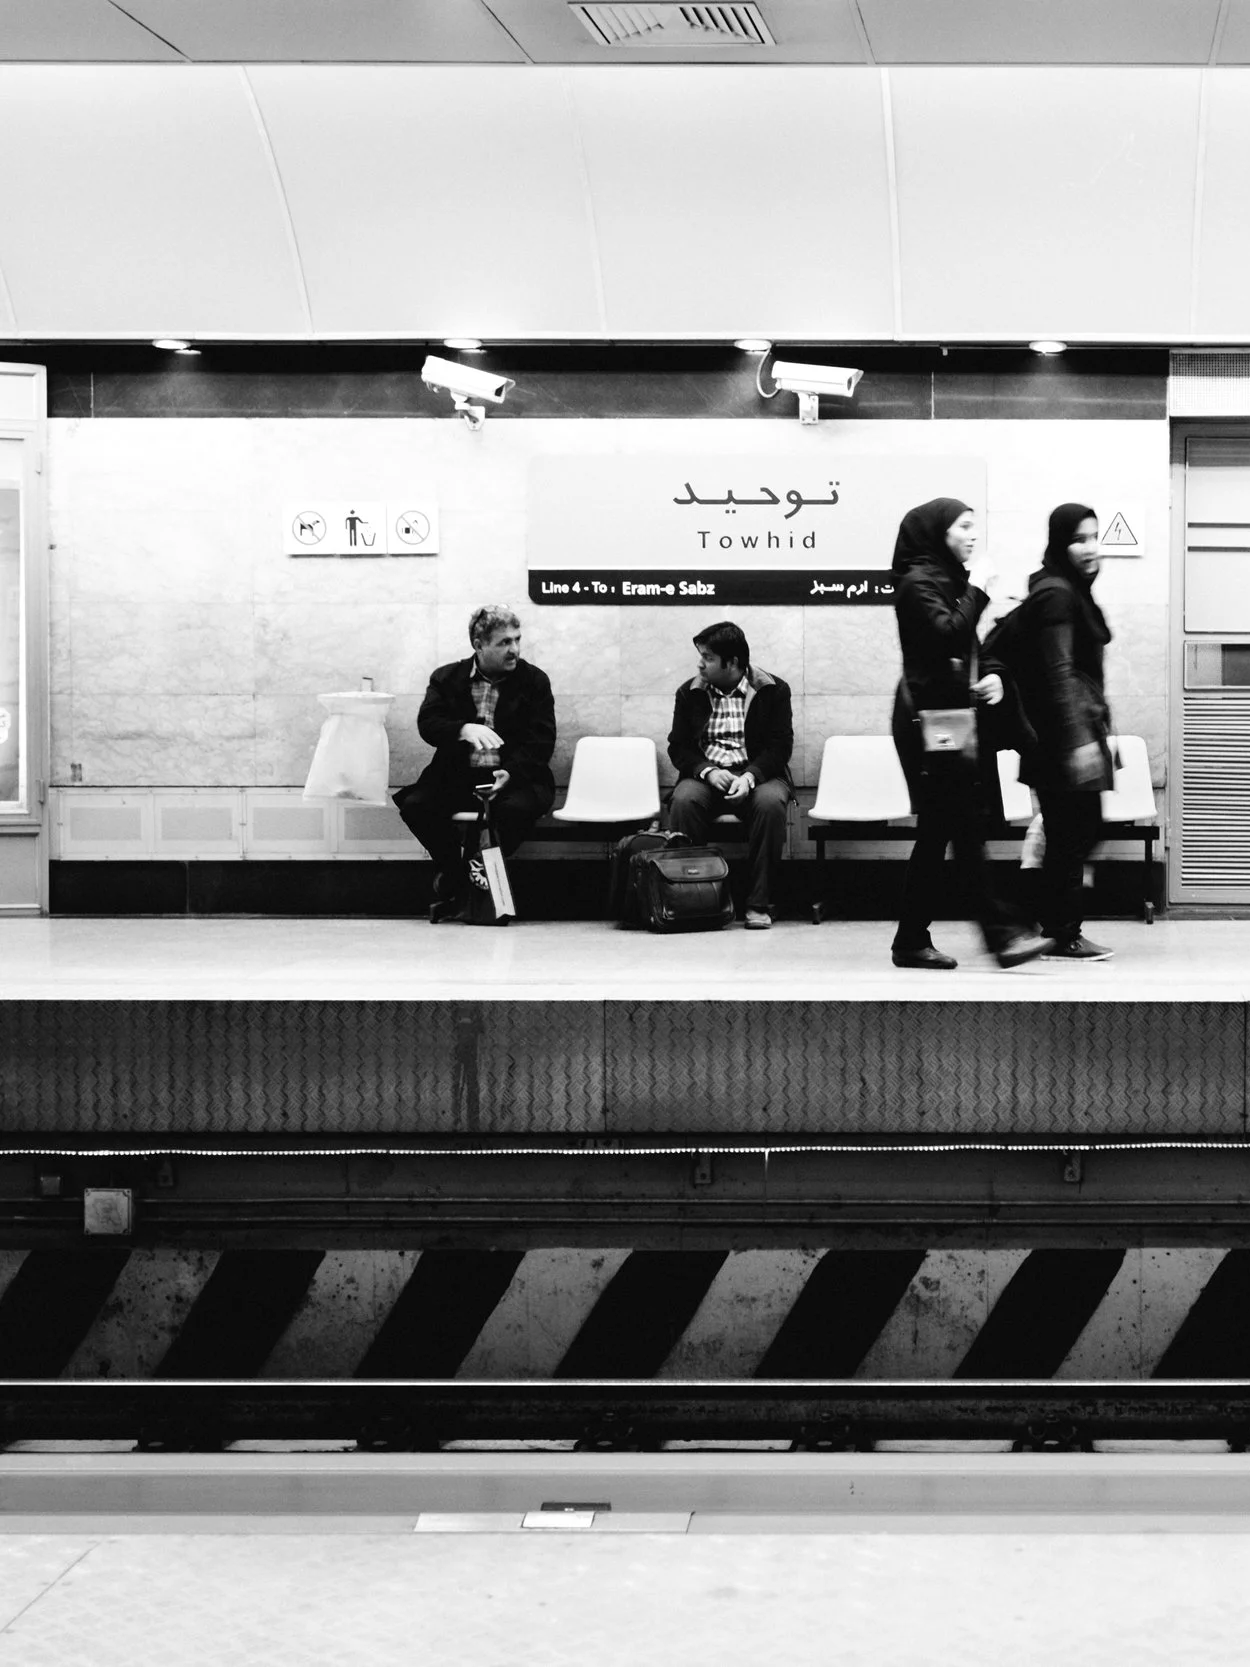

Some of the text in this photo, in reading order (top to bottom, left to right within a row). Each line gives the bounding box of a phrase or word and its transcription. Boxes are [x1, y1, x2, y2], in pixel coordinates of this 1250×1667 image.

[672, 481, 840, 520] توحید
[697, 530, 816, 549] Towhid
[541, 581, 570, 594] Line
[571, 581, 582, 594] 4
[590, 580, 608, 594] To
[621, 581, 676, 596] Eram-e
[678, 579, 716, 596] Sabz
[809, 579, 845, 595] سبز
[846, 579, 869, 599] ارم
